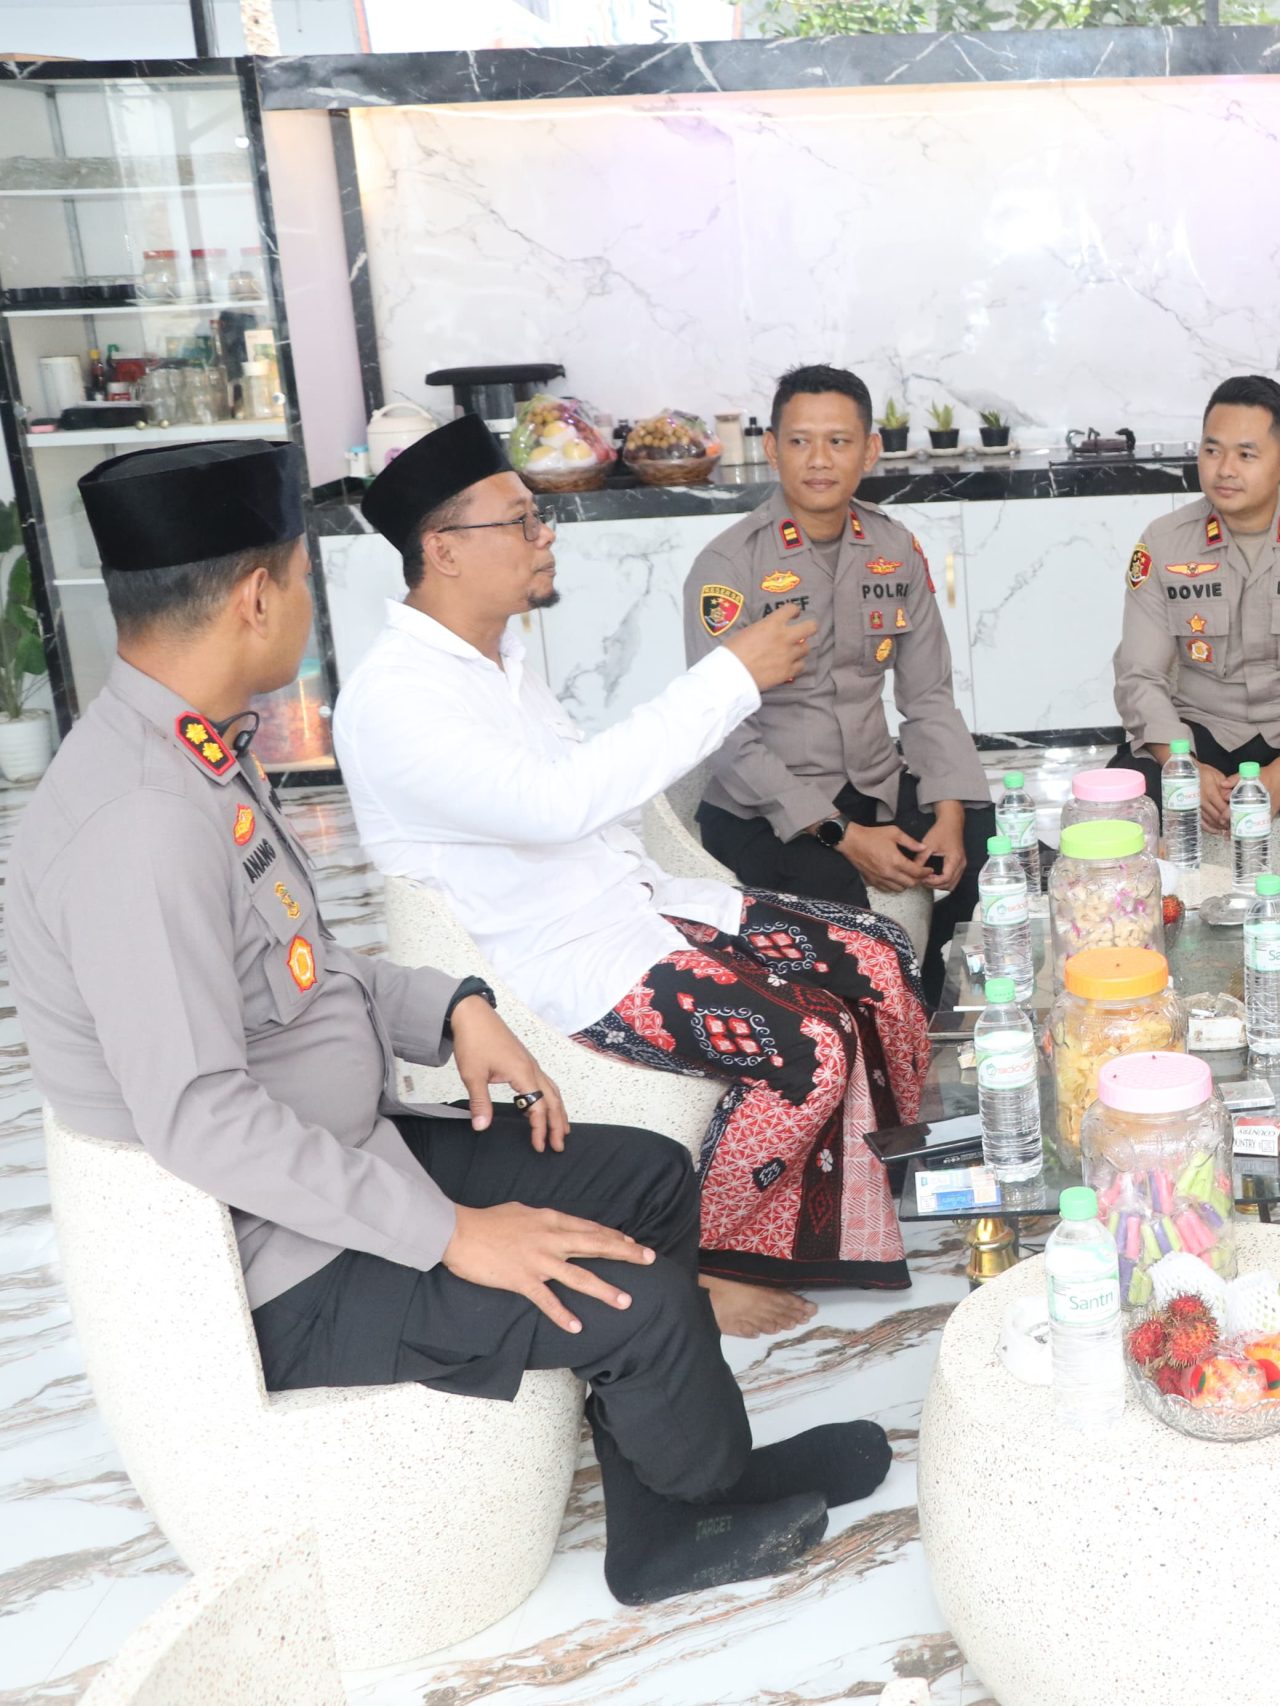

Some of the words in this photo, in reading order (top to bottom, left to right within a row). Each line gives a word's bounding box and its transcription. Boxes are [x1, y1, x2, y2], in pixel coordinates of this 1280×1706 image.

[862, 582, 909, 599] POLRI
[1167, 582, 1222, 600] DOVIE
[242, 838, 276, 884] ANANG
[1069, 1291, 1114, 1310] Santri
